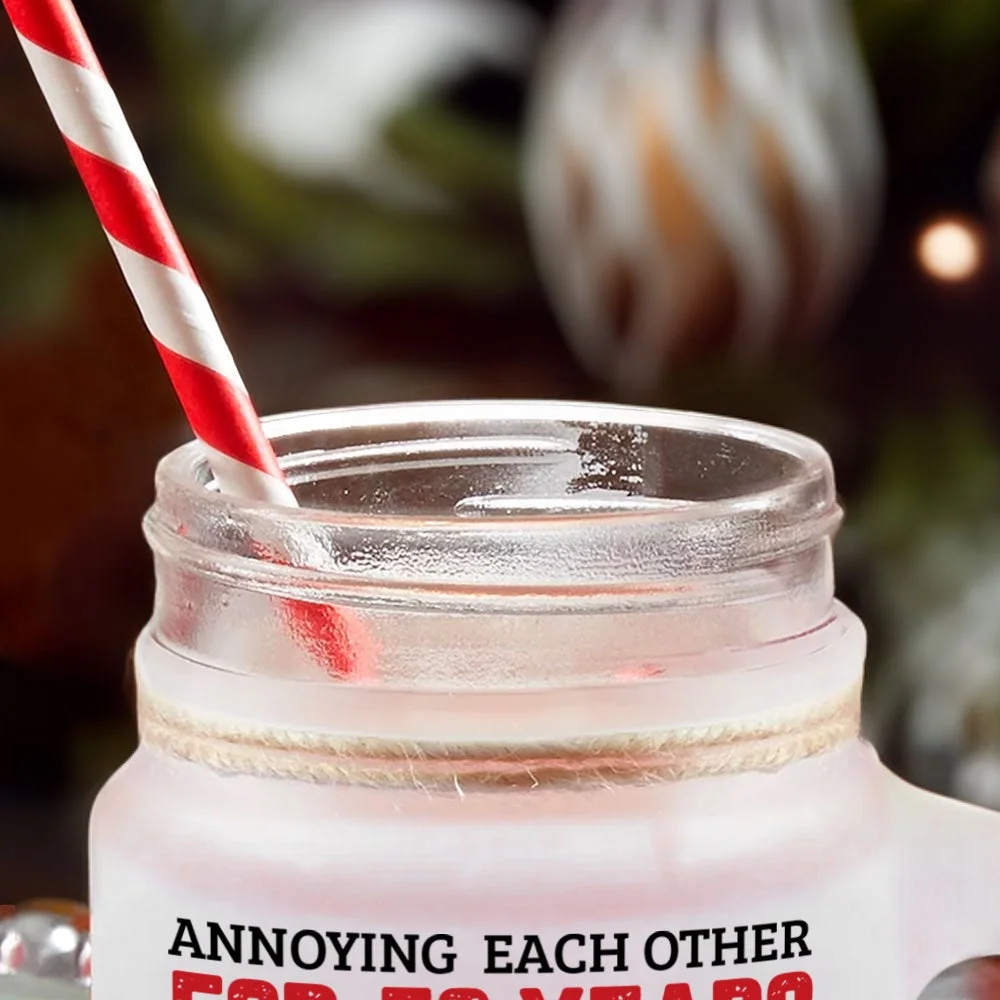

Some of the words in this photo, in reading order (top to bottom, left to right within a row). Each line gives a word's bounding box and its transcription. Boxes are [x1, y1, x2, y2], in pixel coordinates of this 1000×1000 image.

[167, 917, 458, 975] ANNOYING
[483, 932, 630, 975] EACH
[643, 919, 812, 972] OTHER
